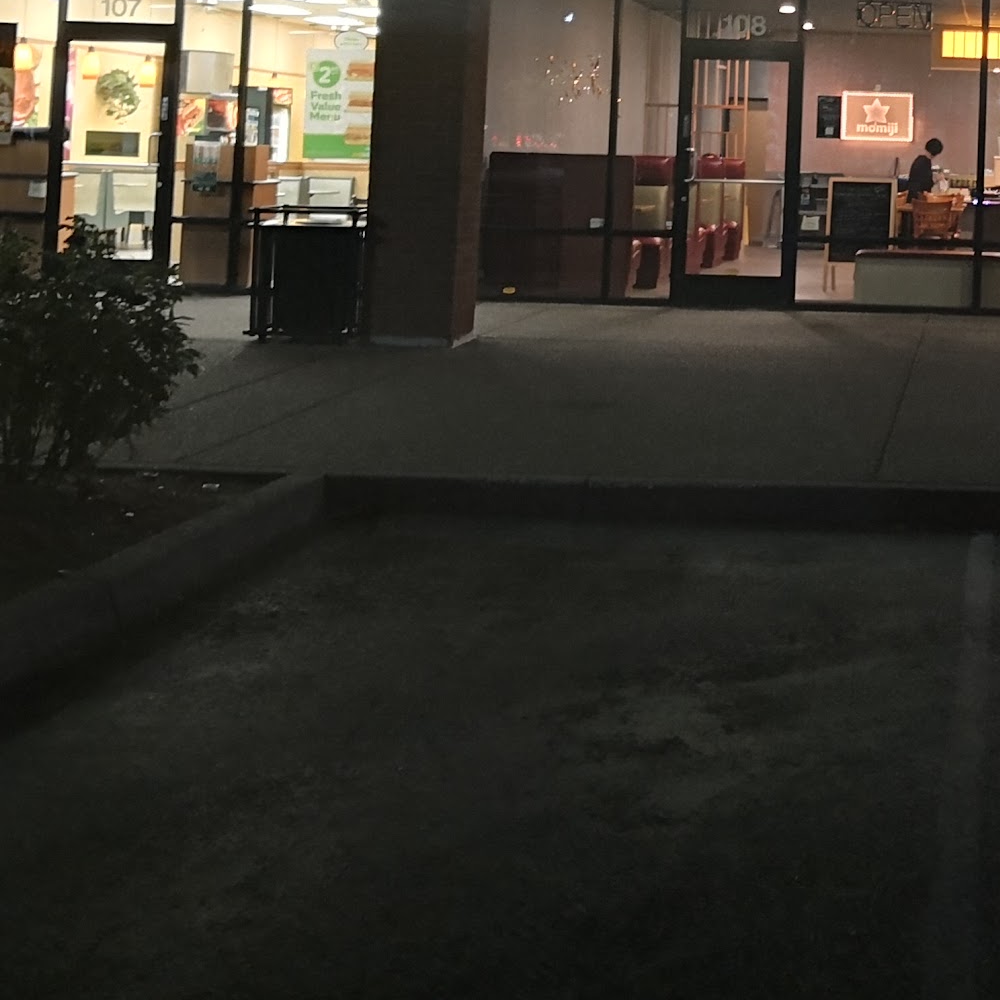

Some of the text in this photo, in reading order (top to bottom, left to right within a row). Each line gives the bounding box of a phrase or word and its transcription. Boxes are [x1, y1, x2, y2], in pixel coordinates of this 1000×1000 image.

[859, 3, 931, 30] OPEN
[720, 14, 767, 37] 108
[310, 90, 342, 101] Fresh
[310, 101, 341, 111] Value
[309, 112, 341, 121] Menu
[856, 122, 899, 136] momiji
